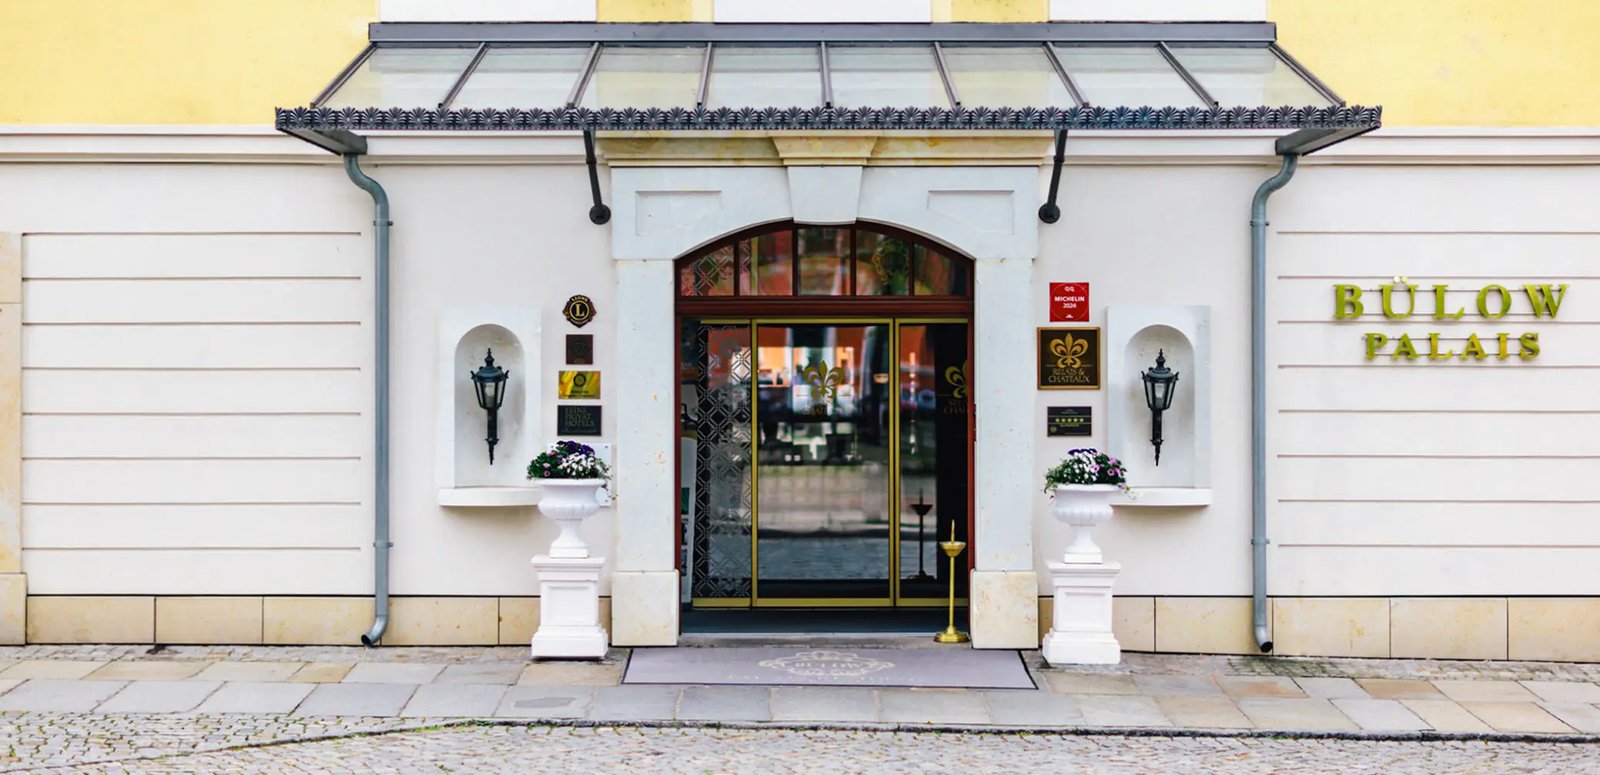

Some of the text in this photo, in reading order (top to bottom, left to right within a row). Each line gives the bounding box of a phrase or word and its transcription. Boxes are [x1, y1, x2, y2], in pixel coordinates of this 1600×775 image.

[1332, 276, 1569, 319] BÜLOW
[575, 304, 585, 317] L
[1363, 332, 1541, 360] PALAIS
[1052, 368, 1086, 376] RELAIS &
